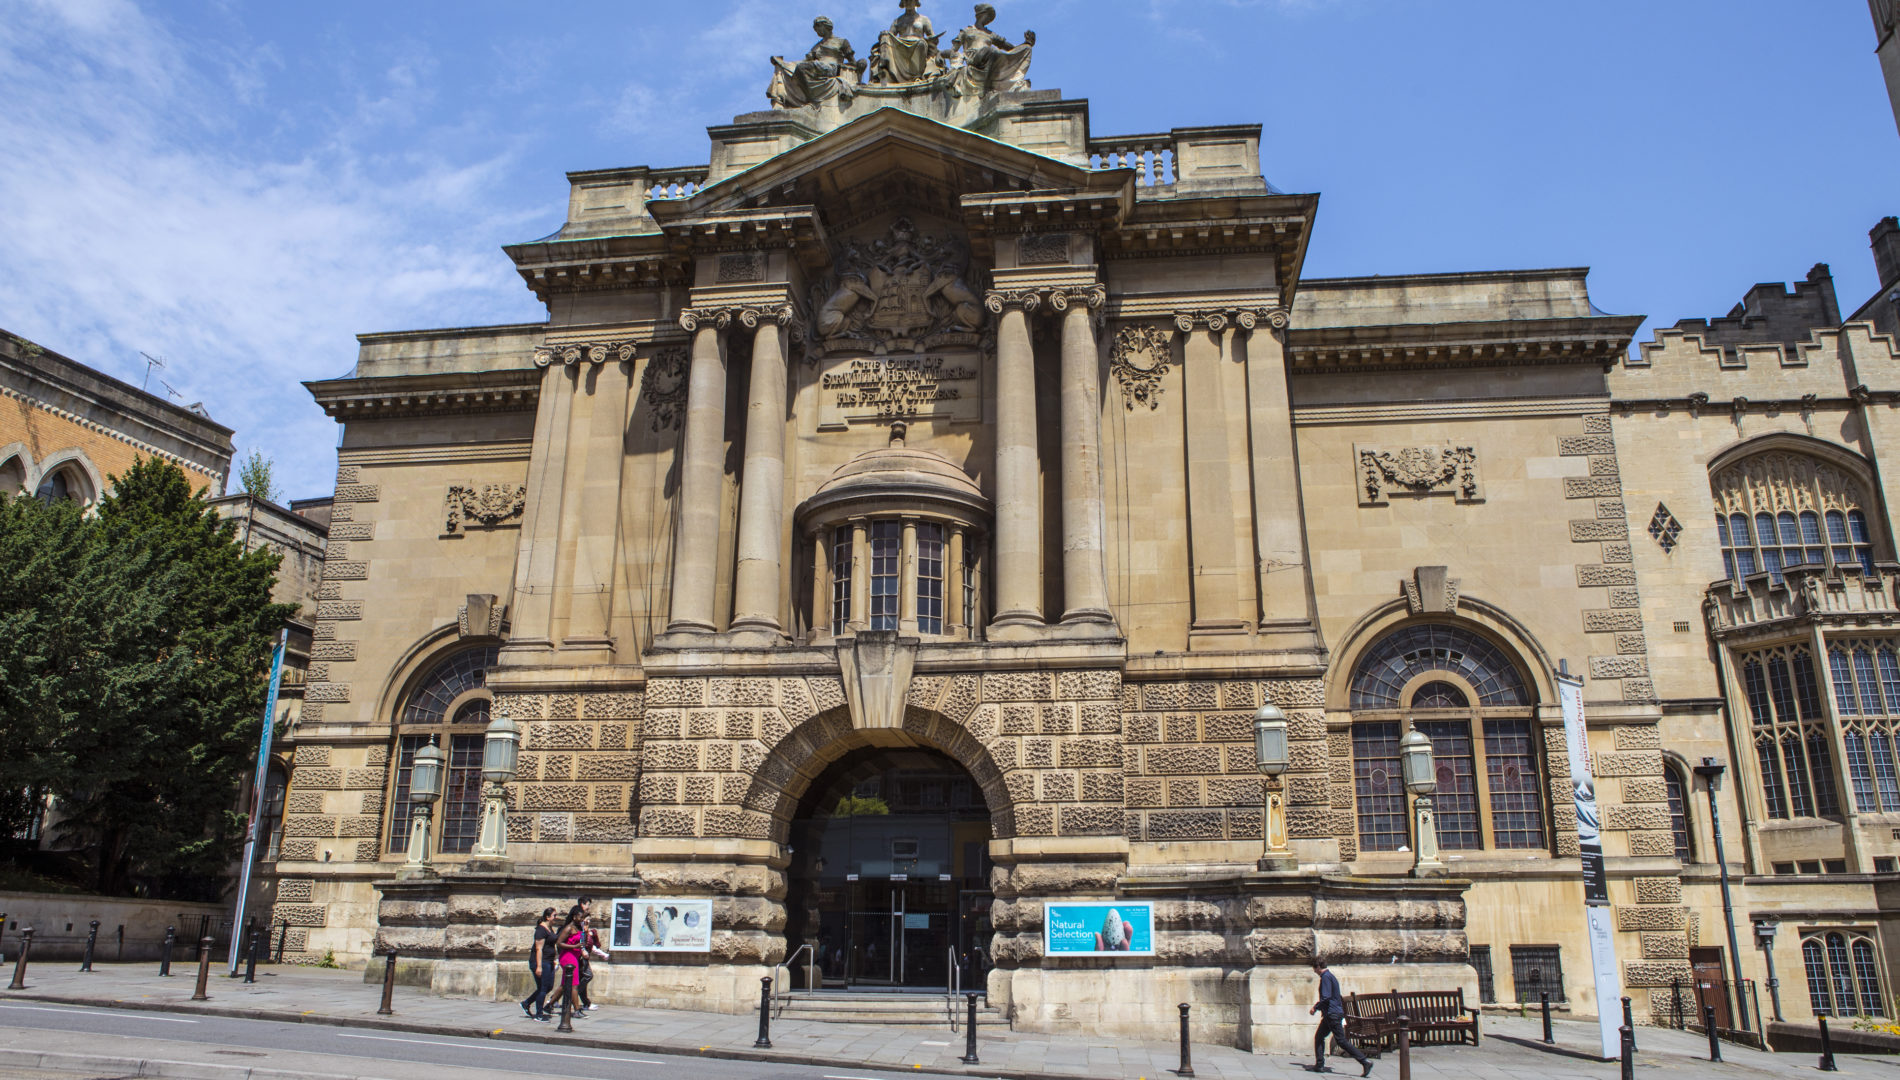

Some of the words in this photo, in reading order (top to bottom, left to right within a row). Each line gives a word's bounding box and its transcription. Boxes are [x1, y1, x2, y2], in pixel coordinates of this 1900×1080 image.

[851, 359, 881, 371] THE
[885, 358, 921, 371] GIFT
[923, 357, 944, 370] OF
[823, 372, 841, 385] SIR
[842, 371, 885, 385] WILLIAM
[886, 370, 922, 383] HENRY
[887, 382, 910, 392] TO
[837, 392, 857, 404] HIS
[859, 391, 904, 403] FELLOW
[1575, 690, 1584, 723] Prints
[1580, 726, 1591, 774] Japanese
[1051, 919, 1085, 929] Natural
[1051, 929, 1094, 939] Selection
